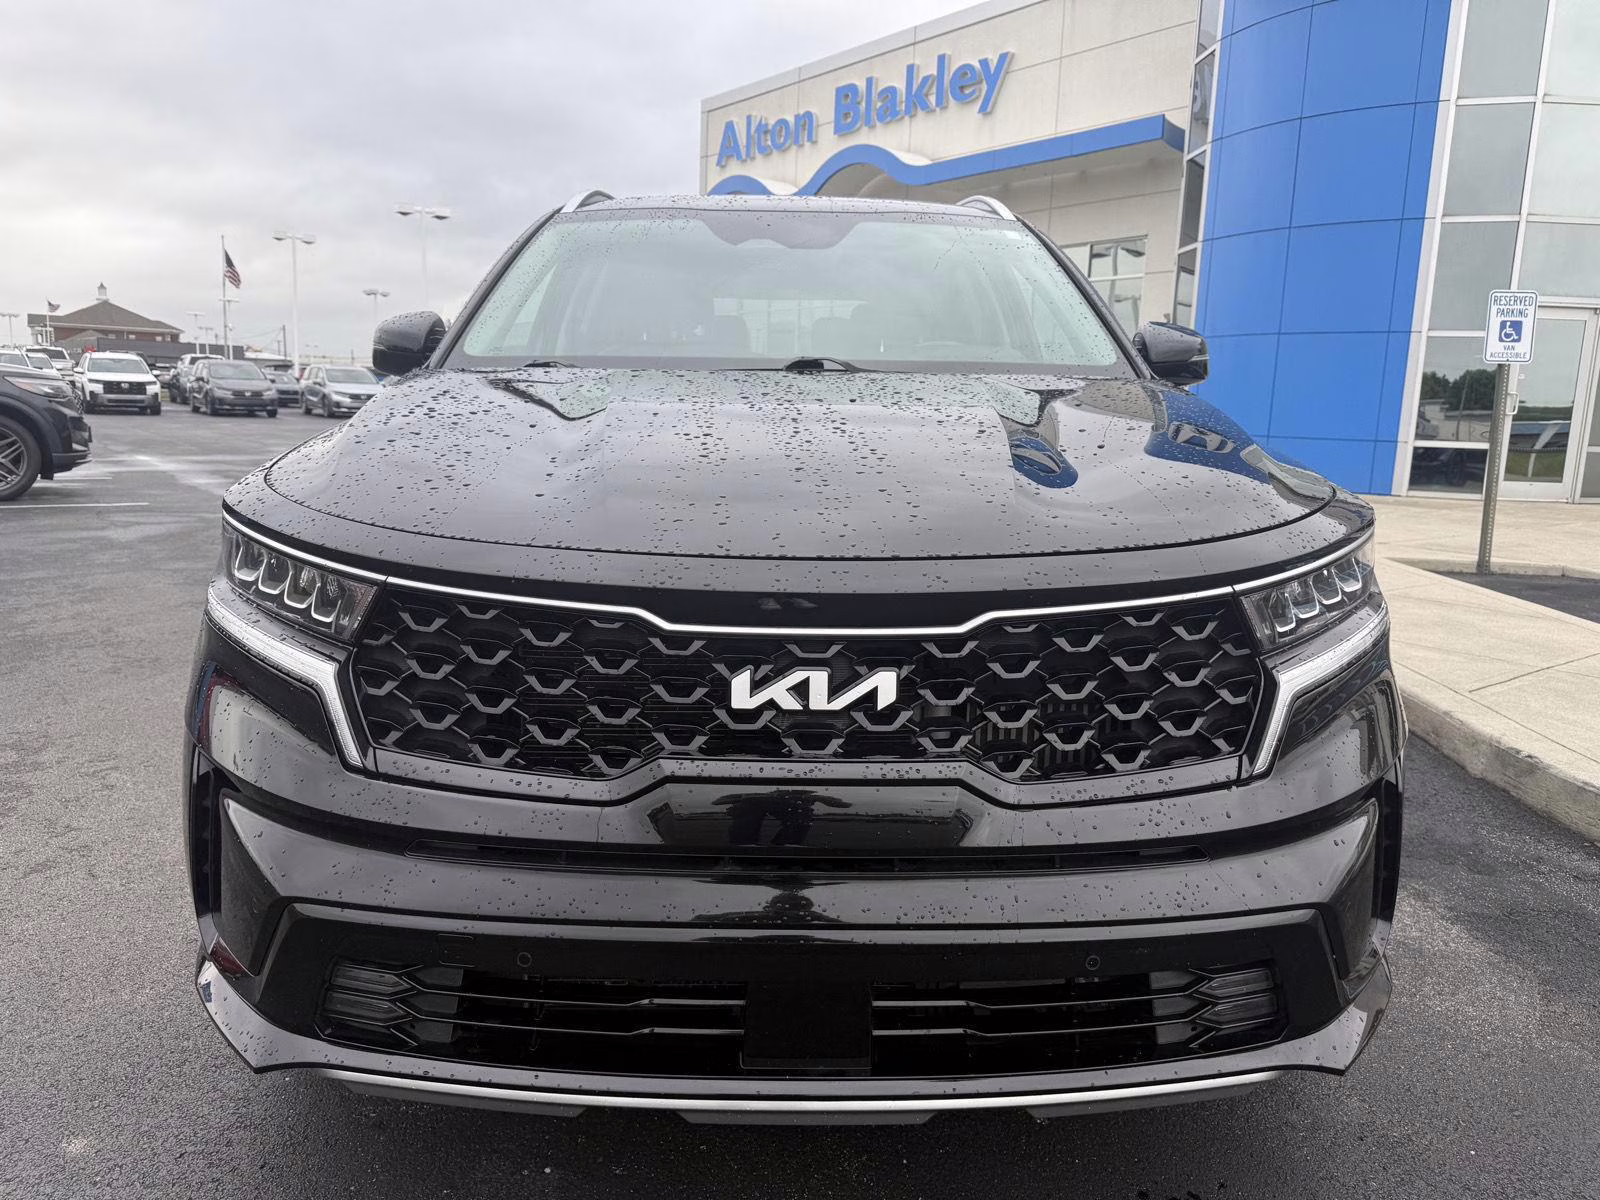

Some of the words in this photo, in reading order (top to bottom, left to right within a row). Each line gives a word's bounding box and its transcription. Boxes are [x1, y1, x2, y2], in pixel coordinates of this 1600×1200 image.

[715, 110, 819, 168] Alton
[833, 51, 1013, 136] Blakley
[1493, 295, 1534, 306] RESERVED
[1496, 307, 1528, 318] PARKING
